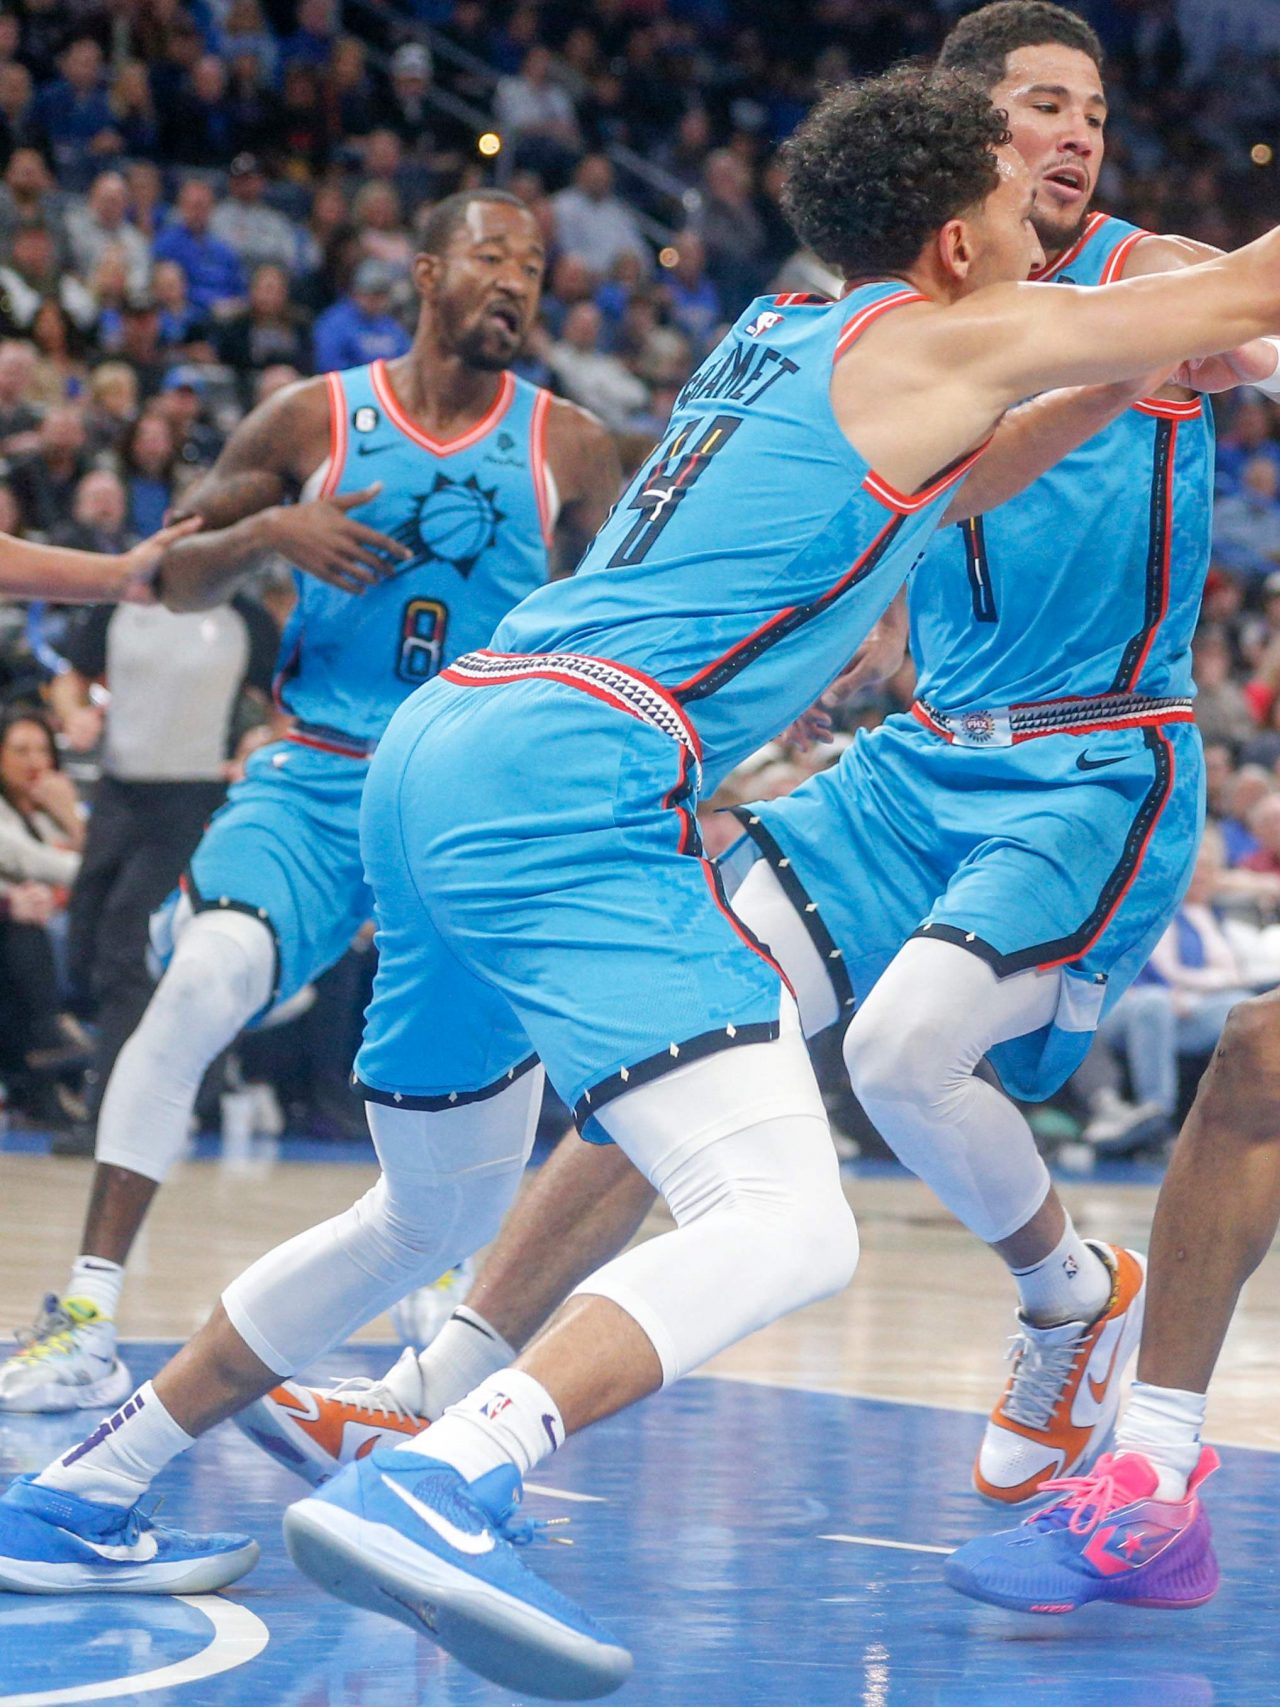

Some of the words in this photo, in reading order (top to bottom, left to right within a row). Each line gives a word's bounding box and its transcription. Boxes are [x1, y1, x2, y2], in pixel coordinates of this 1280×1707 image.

[574, 414, 745, 576] 4
[957, 514, 999, 623] 1
[394, 596, 450, 684] 8
